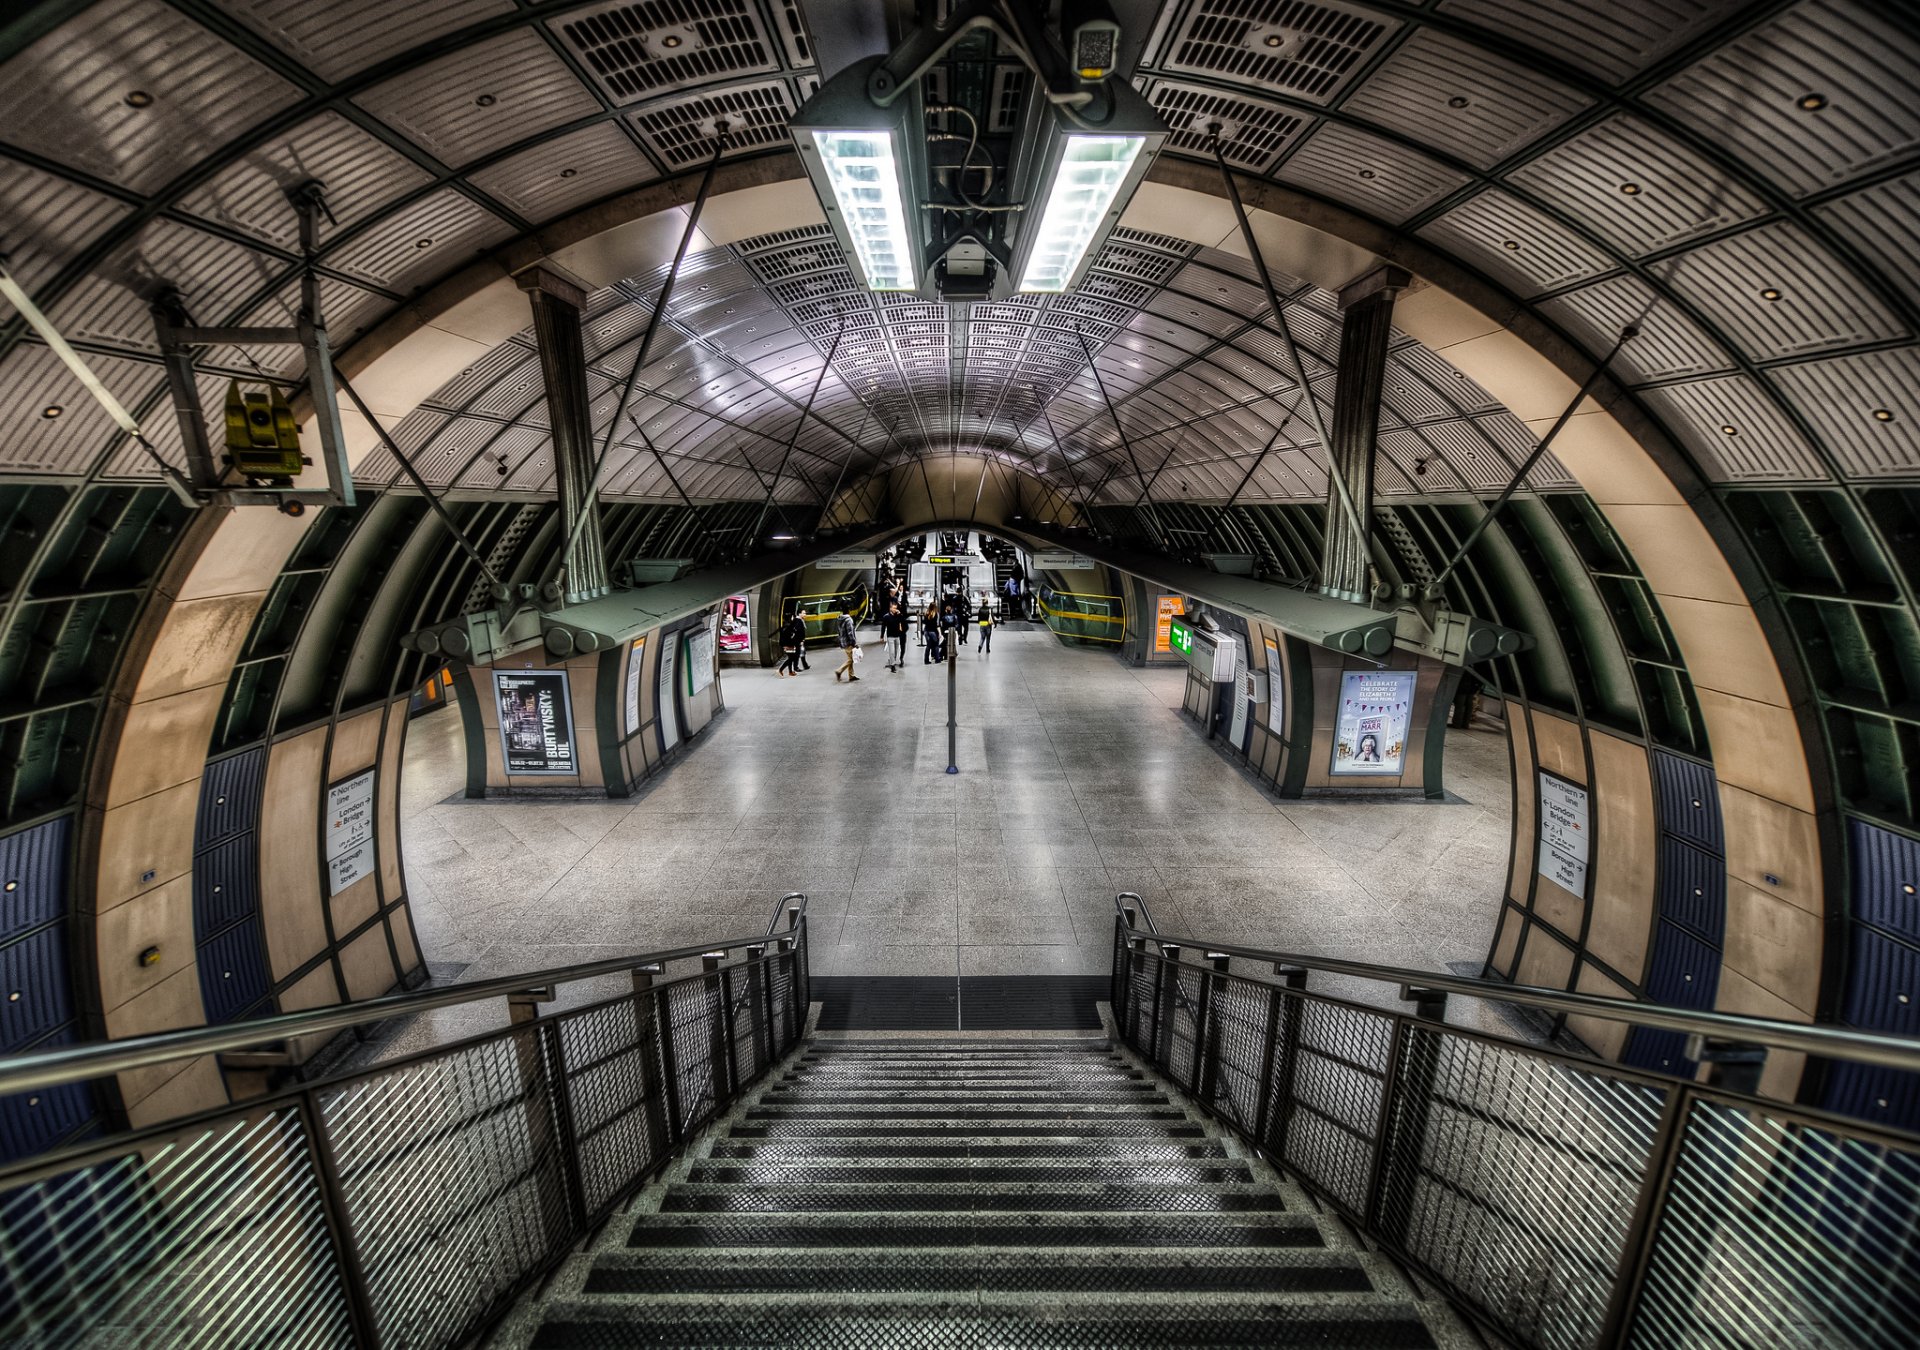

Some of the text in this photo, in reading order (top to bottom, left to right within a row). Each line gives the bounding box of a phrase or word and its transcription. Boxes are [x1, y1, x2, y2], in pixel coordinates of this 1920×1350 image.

[539, 690, 558, 758] BURTYNSKY:
[1361, 723, 1382, 731] MARR
[558, 742, 570, 758] OIL
[337, 777, 369, 795] Northern
[1546, 777, 1578, 798] Northern
[336, 795, 349, 805] line
[1565, 795, 1578, 807] line
[339, 801, 364, 818] London
[1550, 802, 1575, 819] London
[343, 810, 364, 826] Bridge
[1549, 810, 1571, 827] Bridge
[339, 849, 363, 866] Borough
[1551, 849, 1576, 869] Borough
[340, 864, 353, 875] High
[340, 870, 358, 885] Street
[1561, 865, 1575, 879] High
[1556, 872, 1573, 887] Street
